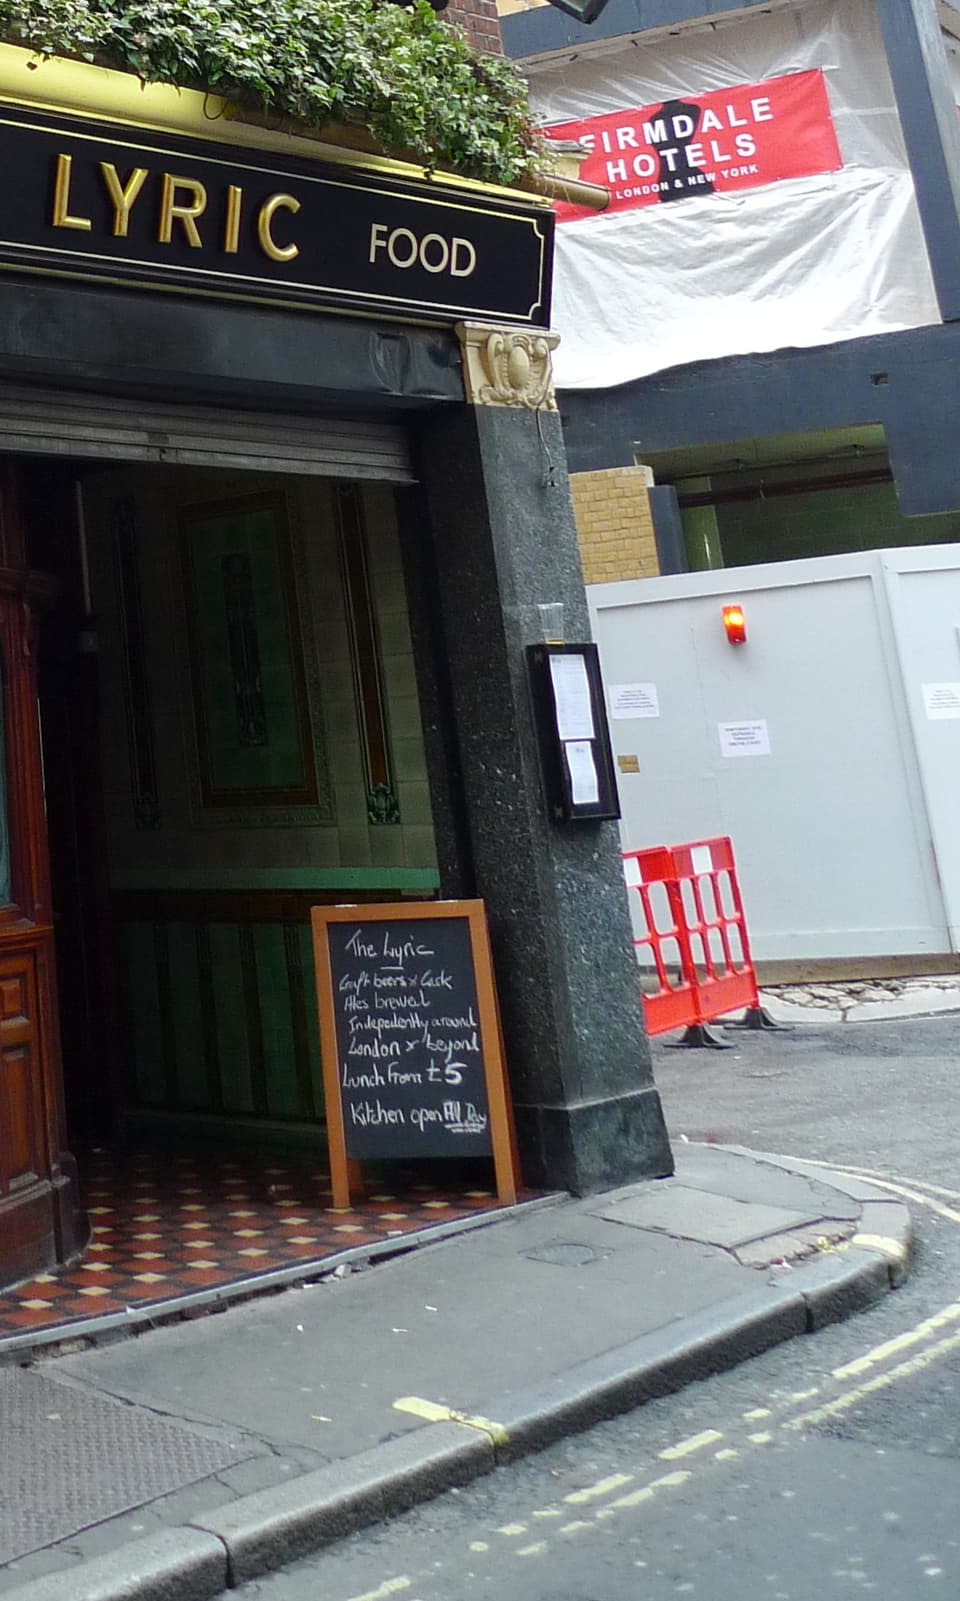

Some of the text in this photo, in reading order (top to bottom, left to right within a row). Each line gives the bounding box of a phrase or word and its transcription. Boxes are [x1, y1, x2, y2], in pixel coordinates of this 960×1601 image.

[579, 96, 774, 154] FIRMDALE
[606, 133, 757, 183] HOTELS
[615, 163, 760, 200] LONDON & NEW YORK
[51, 153, 302, 263] LYRIC
[368, 222, 478, 278] FOOD
[345, 929, 435, 966] The Lyric
[432, 1007, 478, 1028] around
[348, 1037, 400, 1058] London
[426, 1032, 480, 1063] beyond
[342, 1062, 385, 1088] Lunch
[425, 1058, 468, 1085] £5
[350, 1100, 404, 1126] Kitchen
[410, 1107, 442, 1132] open
